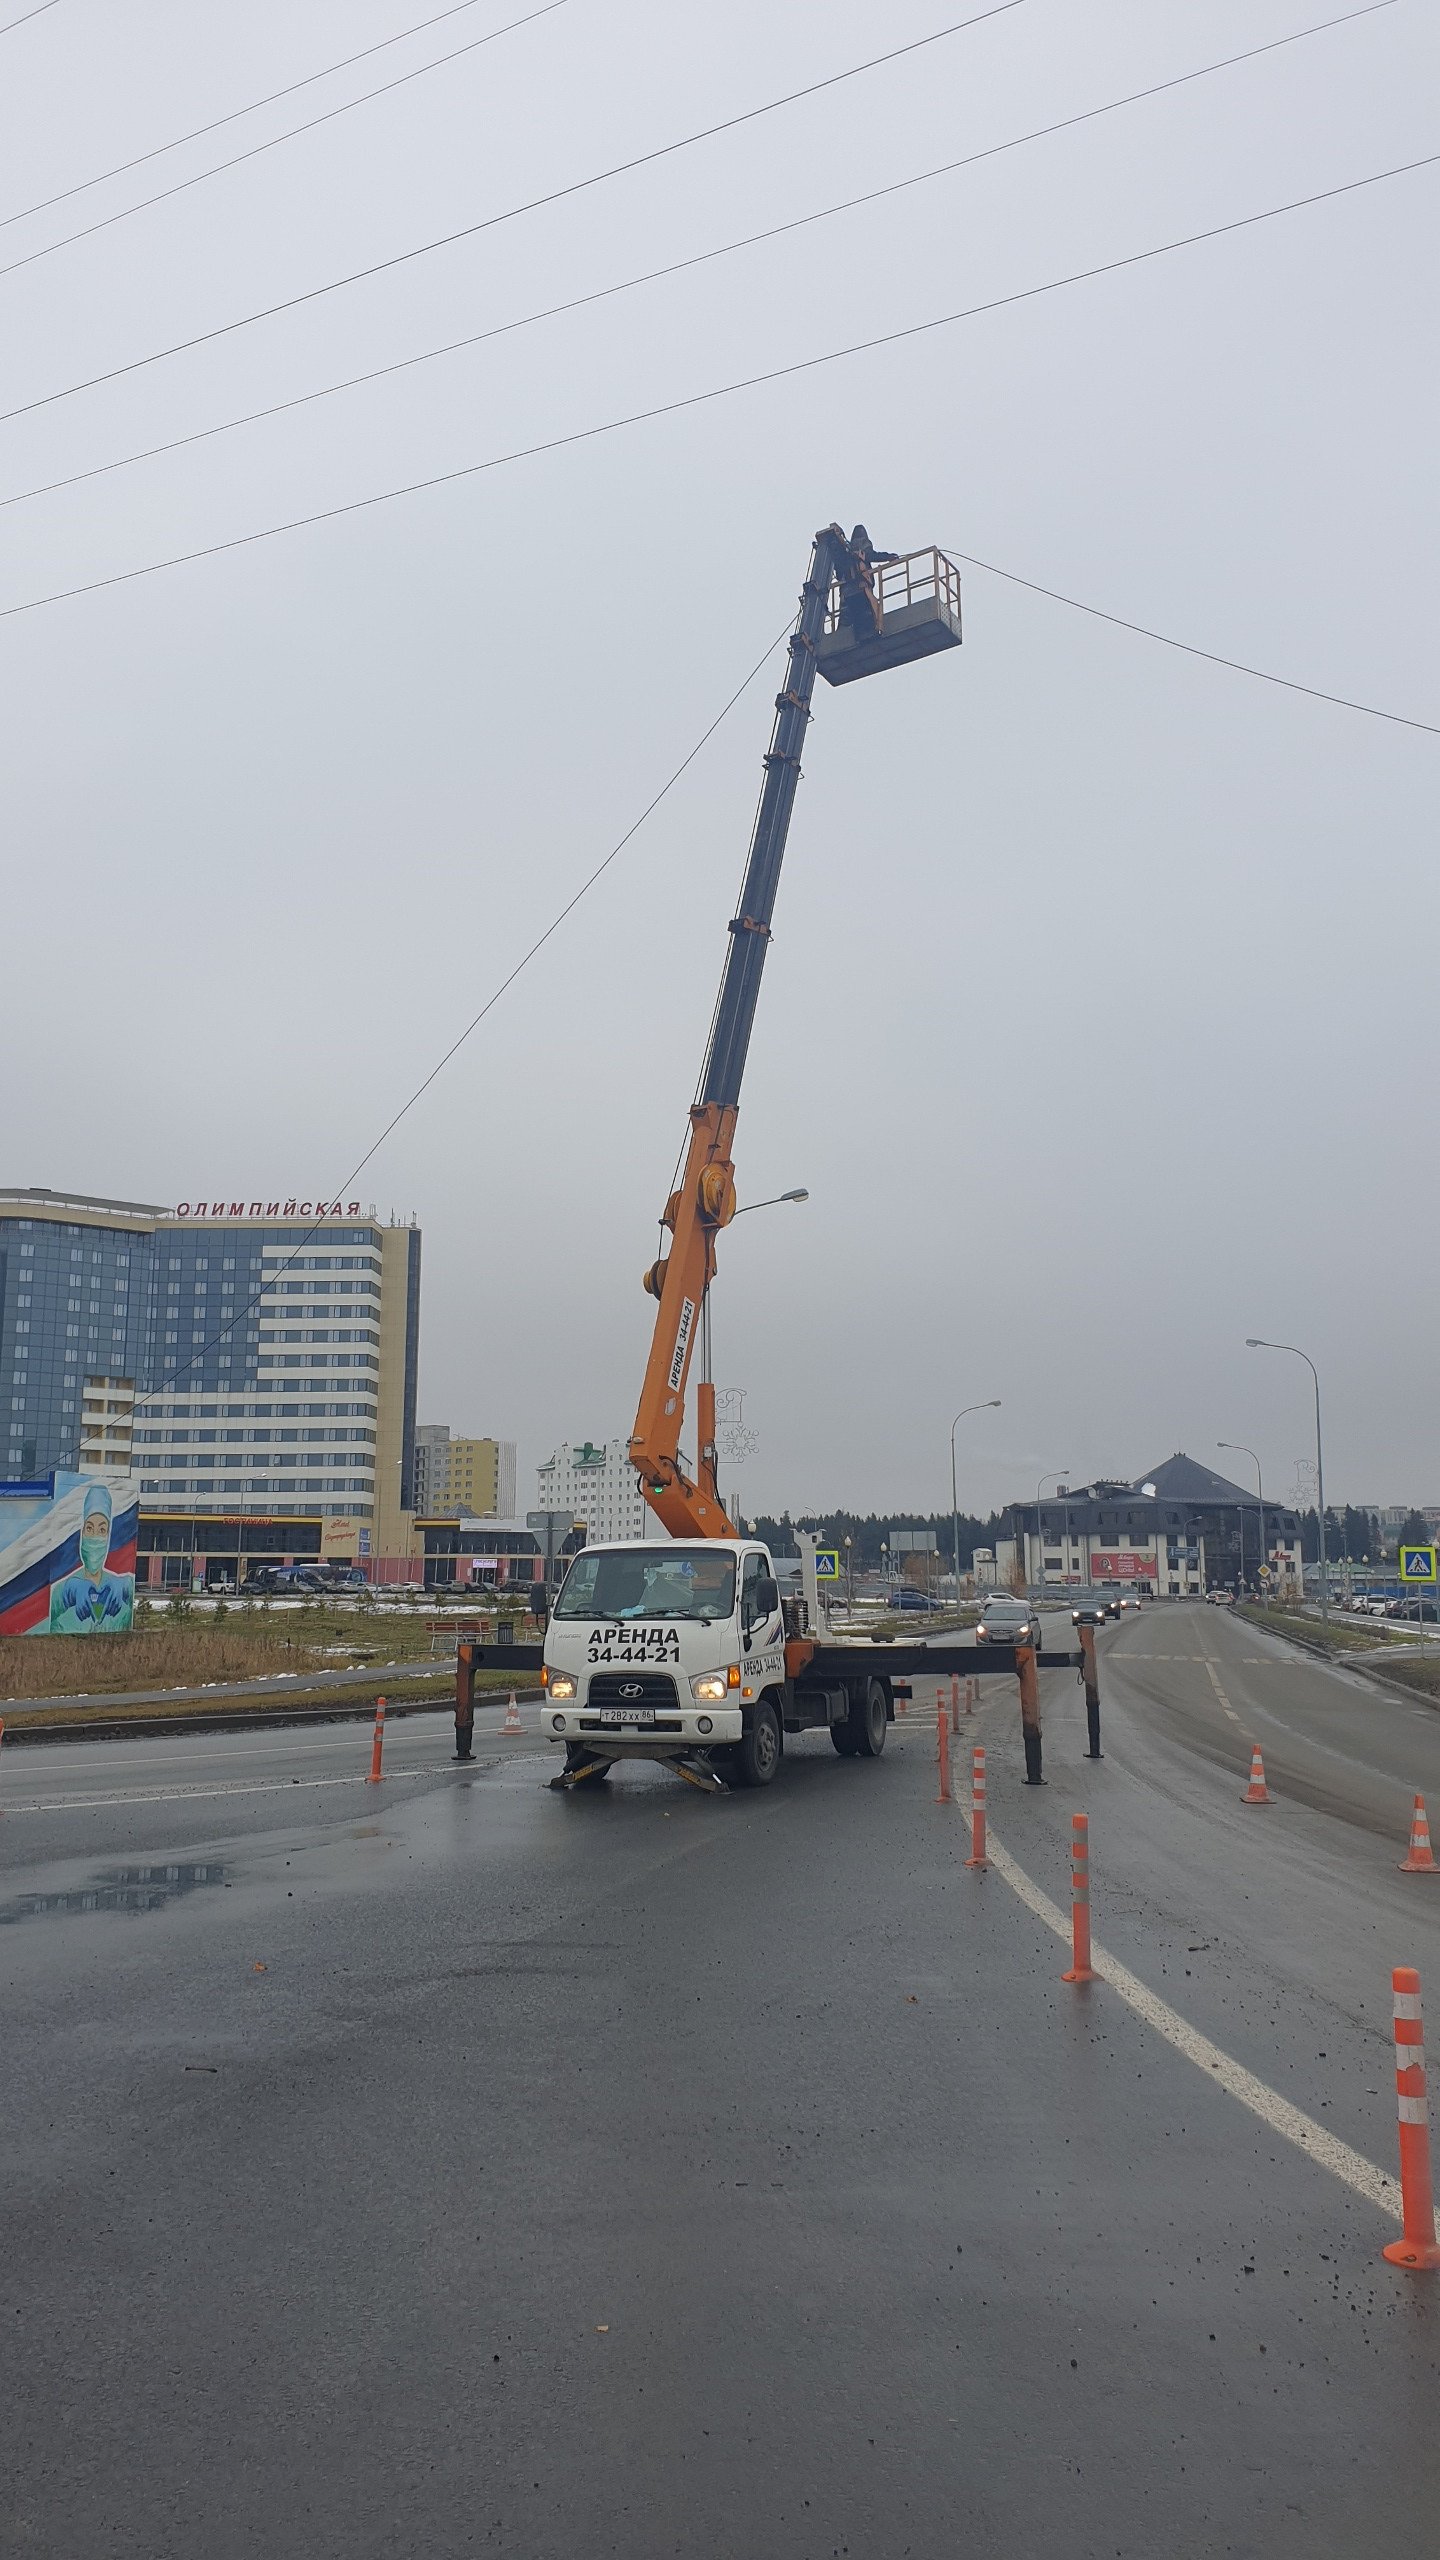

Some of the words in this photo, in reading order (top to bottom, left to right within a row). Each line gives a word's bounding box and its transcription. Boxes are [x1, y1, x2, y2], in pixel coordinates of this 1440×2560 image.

[176, 1198, 361, 1217] ОЛИМПИЙСКАЯ
[670, 1345, 685, 1388] АРЕНДА
[679, 1300, 693, 1342] 34-44-21
[588, 1628, 680, 1647] АРЕНДА
[587, 1646, 680, 1664] 34-44-21
[743, 1659, 764, 1677] АРЕНДА
